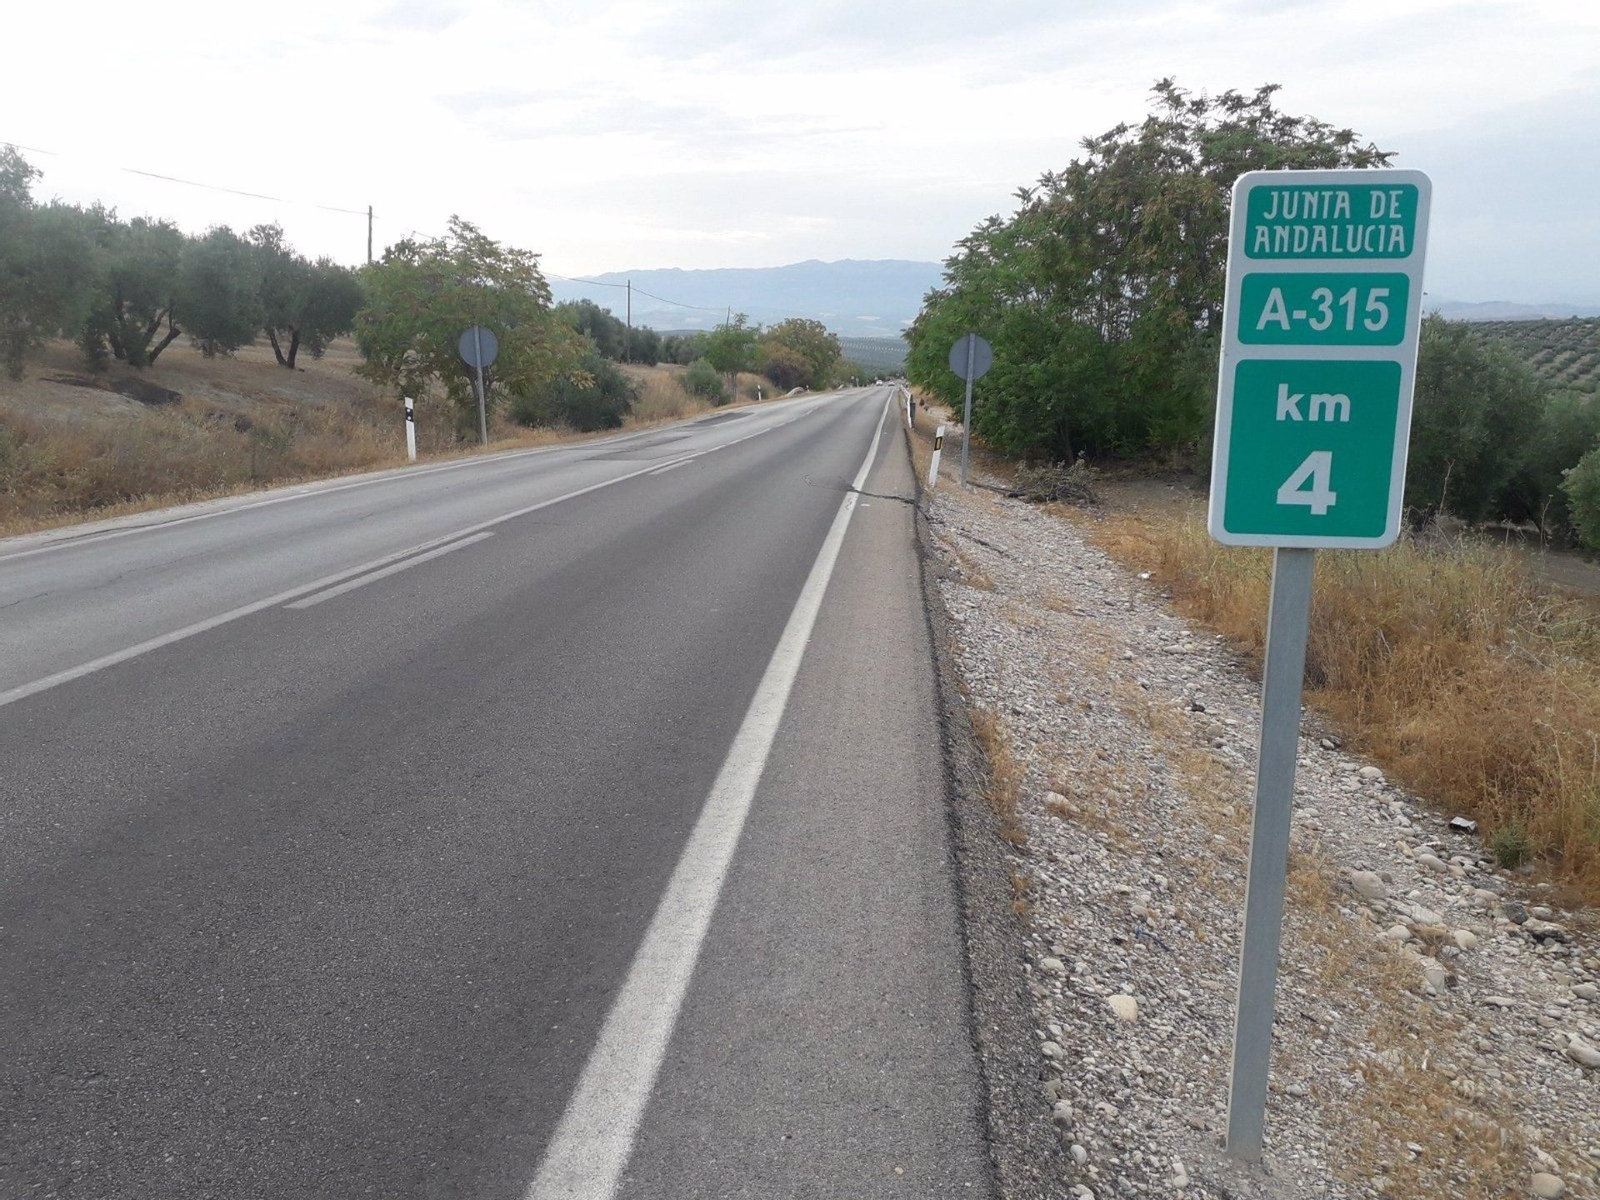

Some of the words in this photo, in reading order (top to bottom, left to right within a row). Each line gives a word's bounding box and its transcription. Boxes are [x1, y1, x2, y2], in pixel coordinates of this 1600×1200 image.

[1263, 190, 1351, 220] JUNTA
[1370, 190, 1404, 219] DE
[1253, 224, 1406, 253] ANDALUCIA
[1256, 287, 1390, 332] A-315
[1275, 383, 1351, 422] km
[1276, 450, 1337, 516] 4
